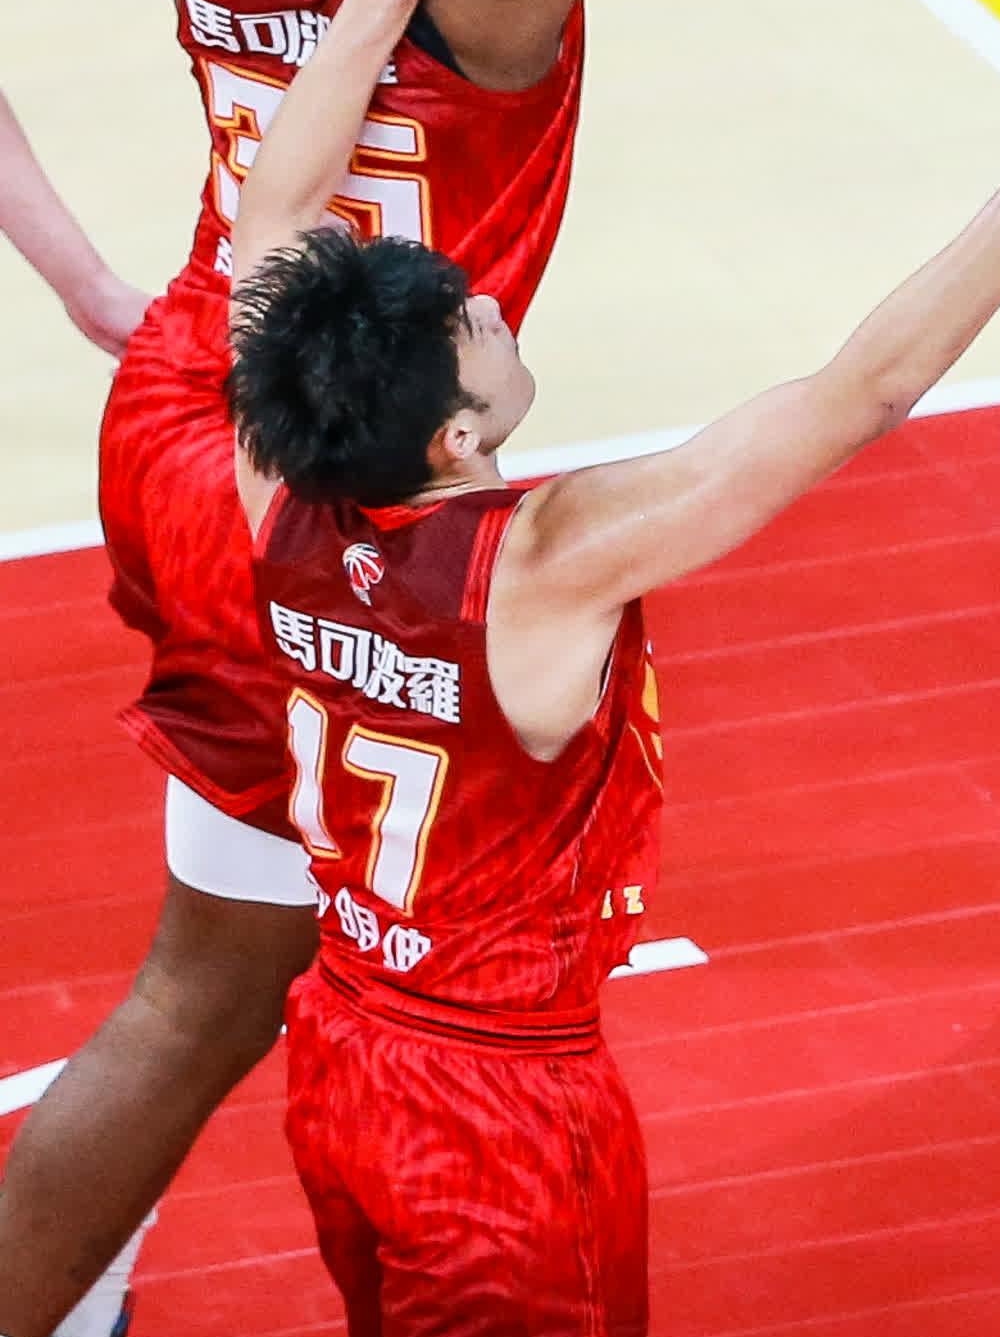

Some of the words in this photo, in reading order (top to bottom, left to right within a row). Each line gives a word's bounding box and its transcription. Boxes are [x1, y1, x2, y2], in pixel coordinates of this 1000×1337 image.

[269, 600, 461, 724] 馬可波羅
[286, 687, 449, 918] 17
